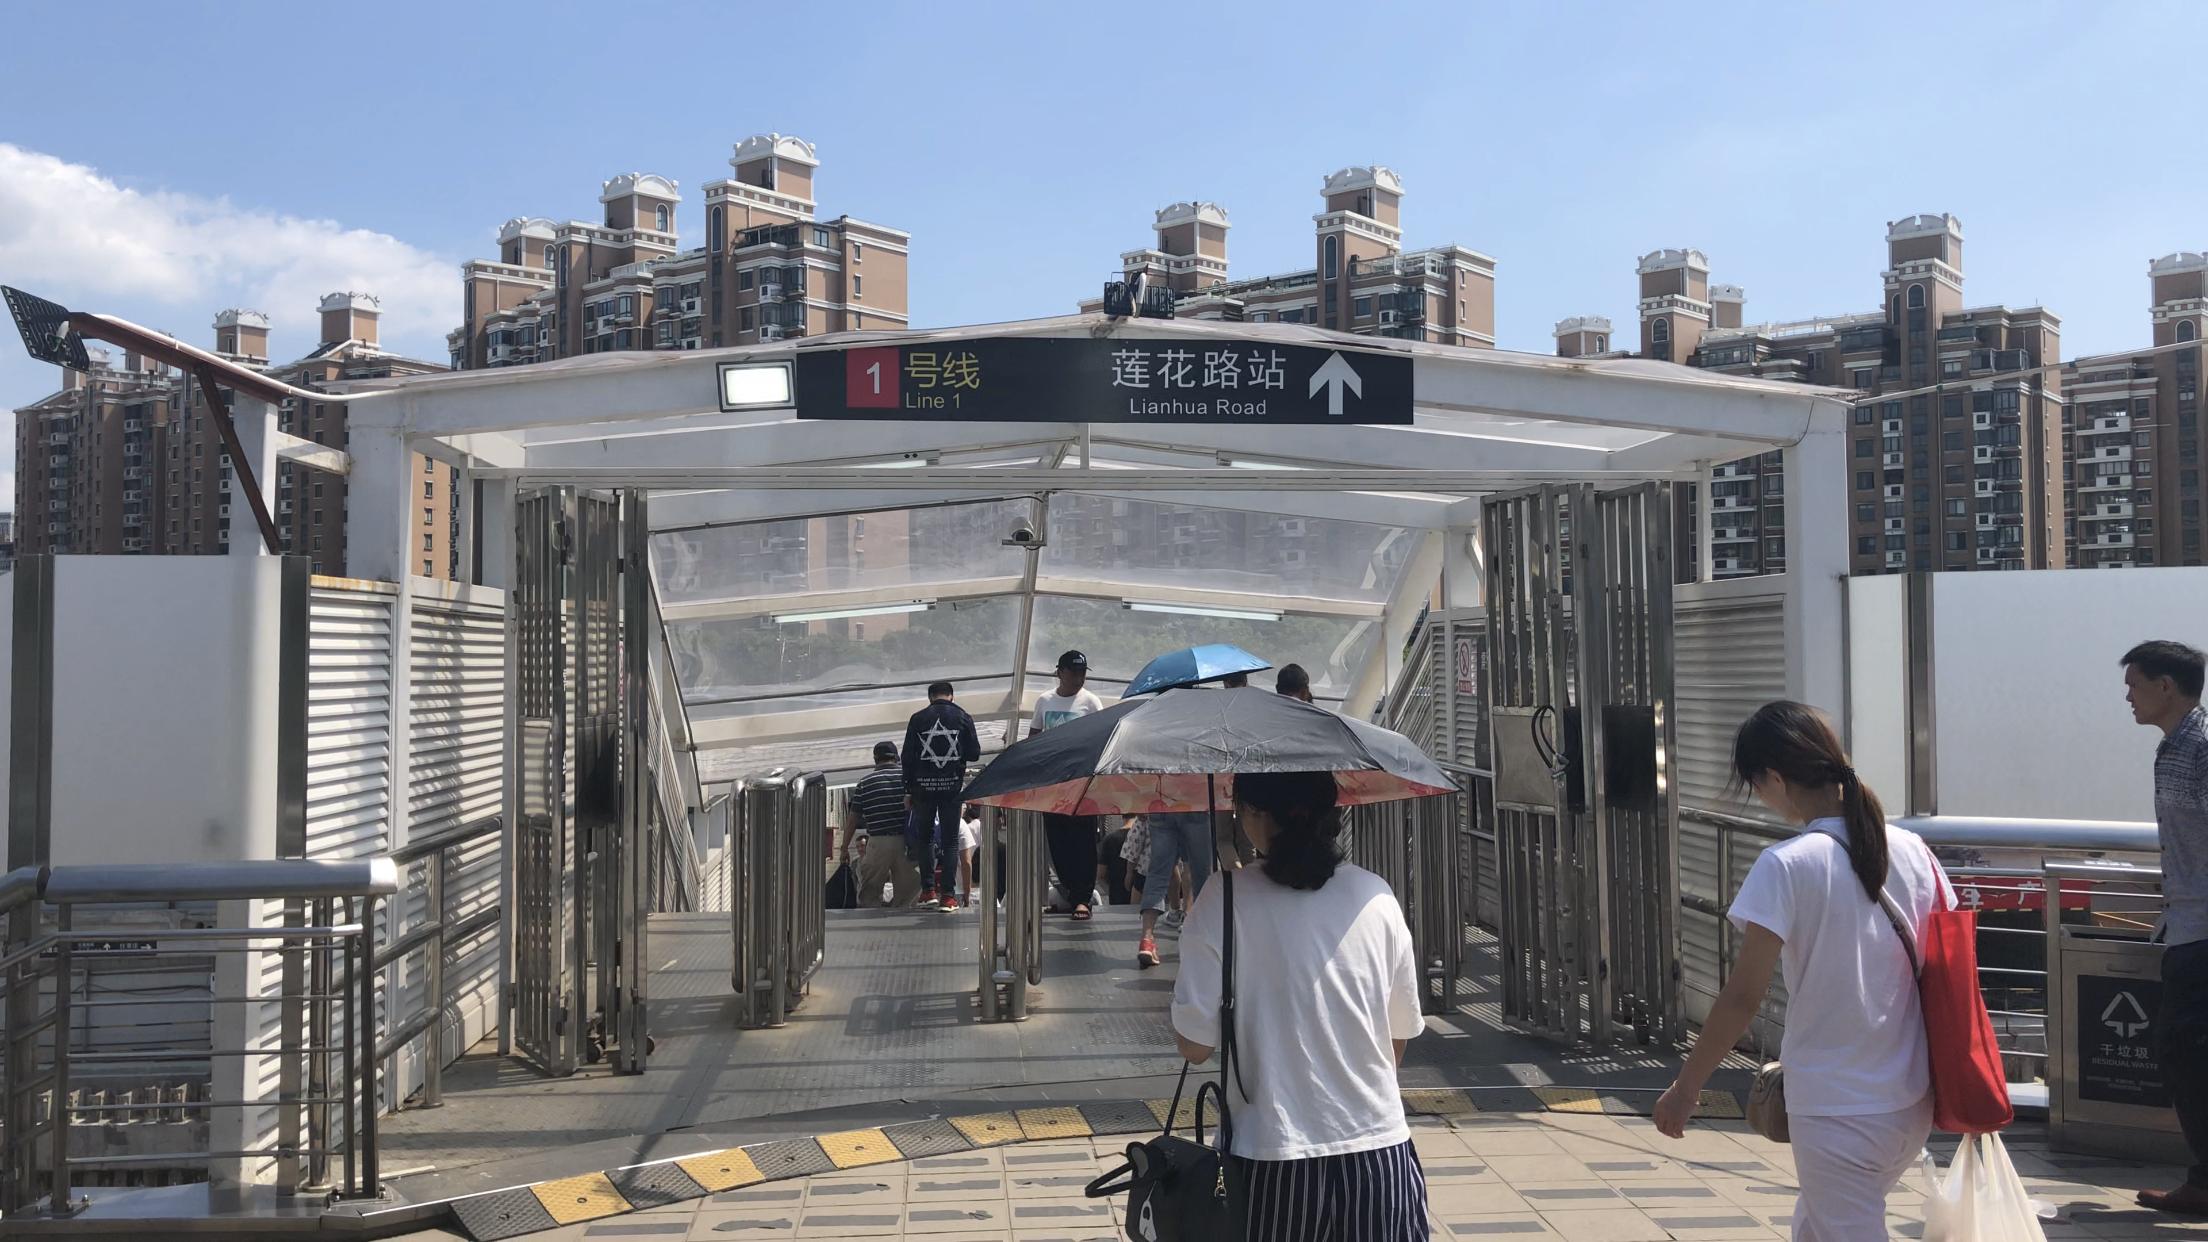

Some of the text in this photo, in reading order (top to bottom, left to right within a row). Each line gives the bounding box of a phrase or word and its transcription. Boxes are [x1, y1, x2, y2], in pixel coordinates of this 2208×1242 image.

[867, 351, 980, 394] 1 号线
[1111, 348, 1286, 390] 莲花路站
[905, 391, 961, 409] Line 1
[1130, 398, 1267, 415] Lianhua Road
[2099, 1043, 2150, 1060] 干垃圾
